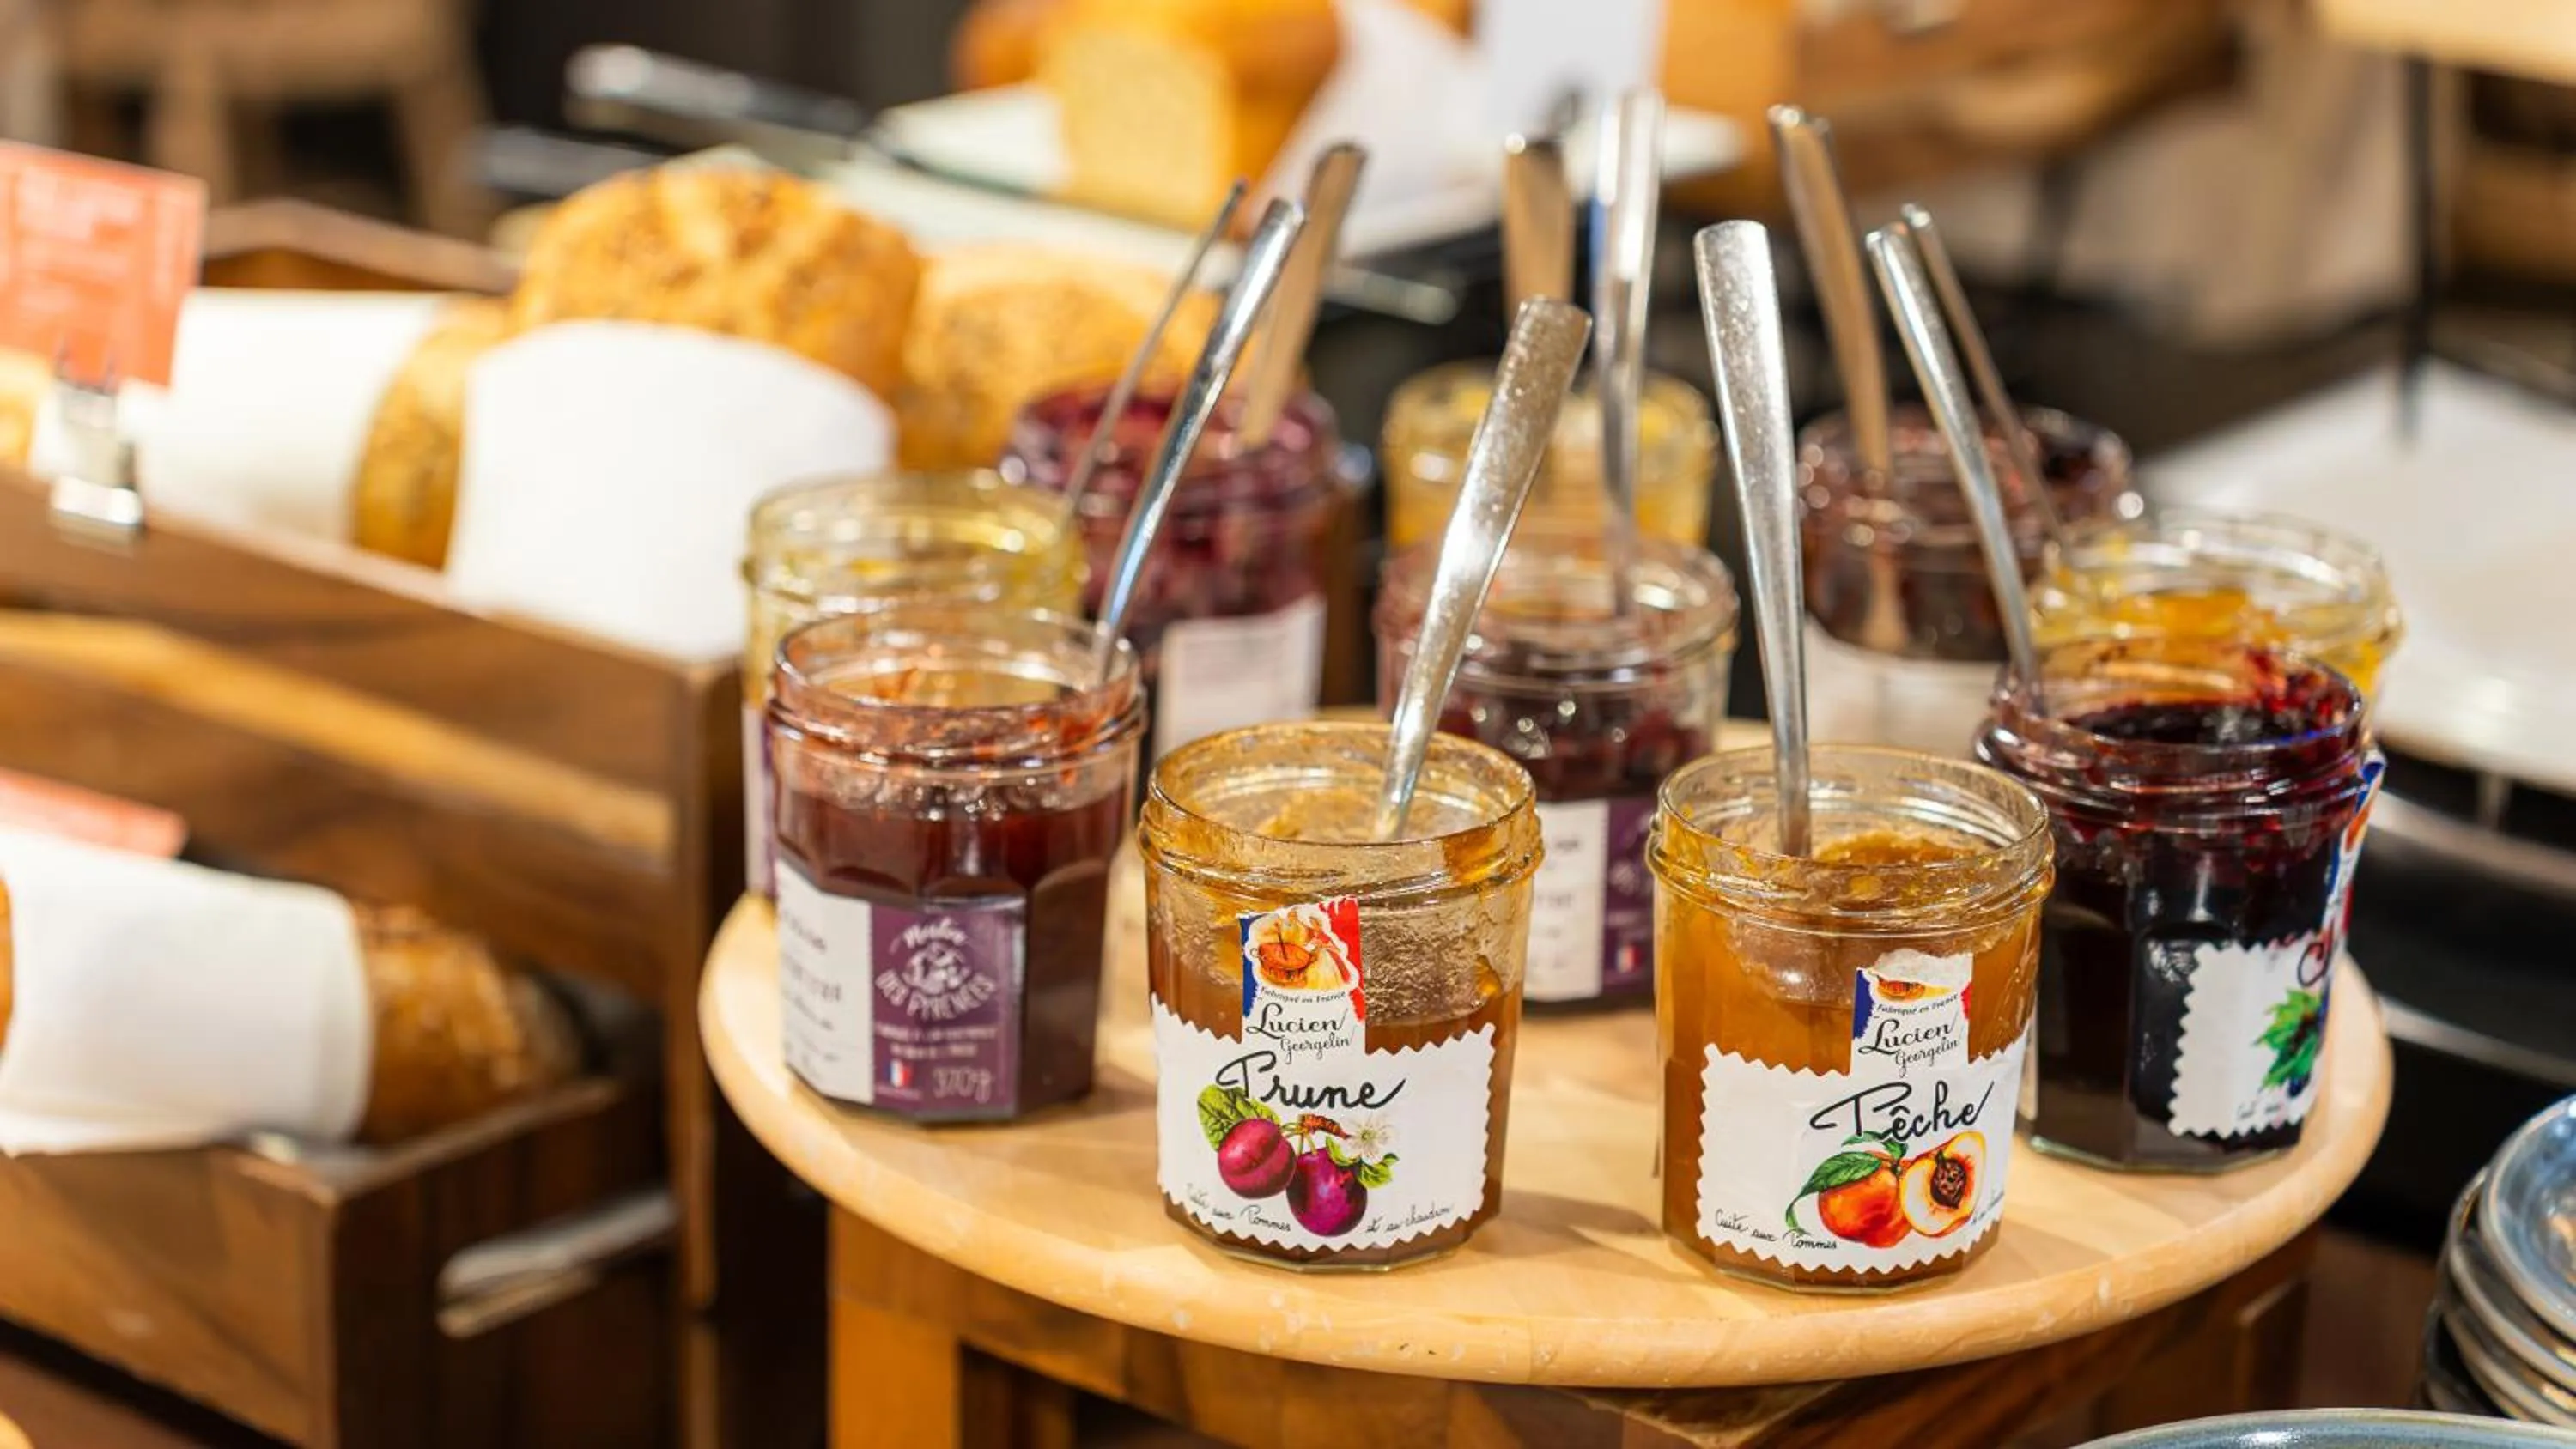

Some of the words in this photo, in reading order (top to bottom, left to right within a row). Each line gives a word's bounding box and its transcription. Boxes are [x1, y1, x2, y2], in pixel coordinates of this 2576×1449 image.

[1246, 1002, 1348, 1040] Lucien
[1857, 1018, 1959, 1055] Lucien
[1280, 1032, 1353, 1064] Georgelin
[1895, 1036, 1961, 1078] Georgelin
[1215, 1050, 1406, 1109] Prune
[1809, 1080, 1995, 1141] Pêche
